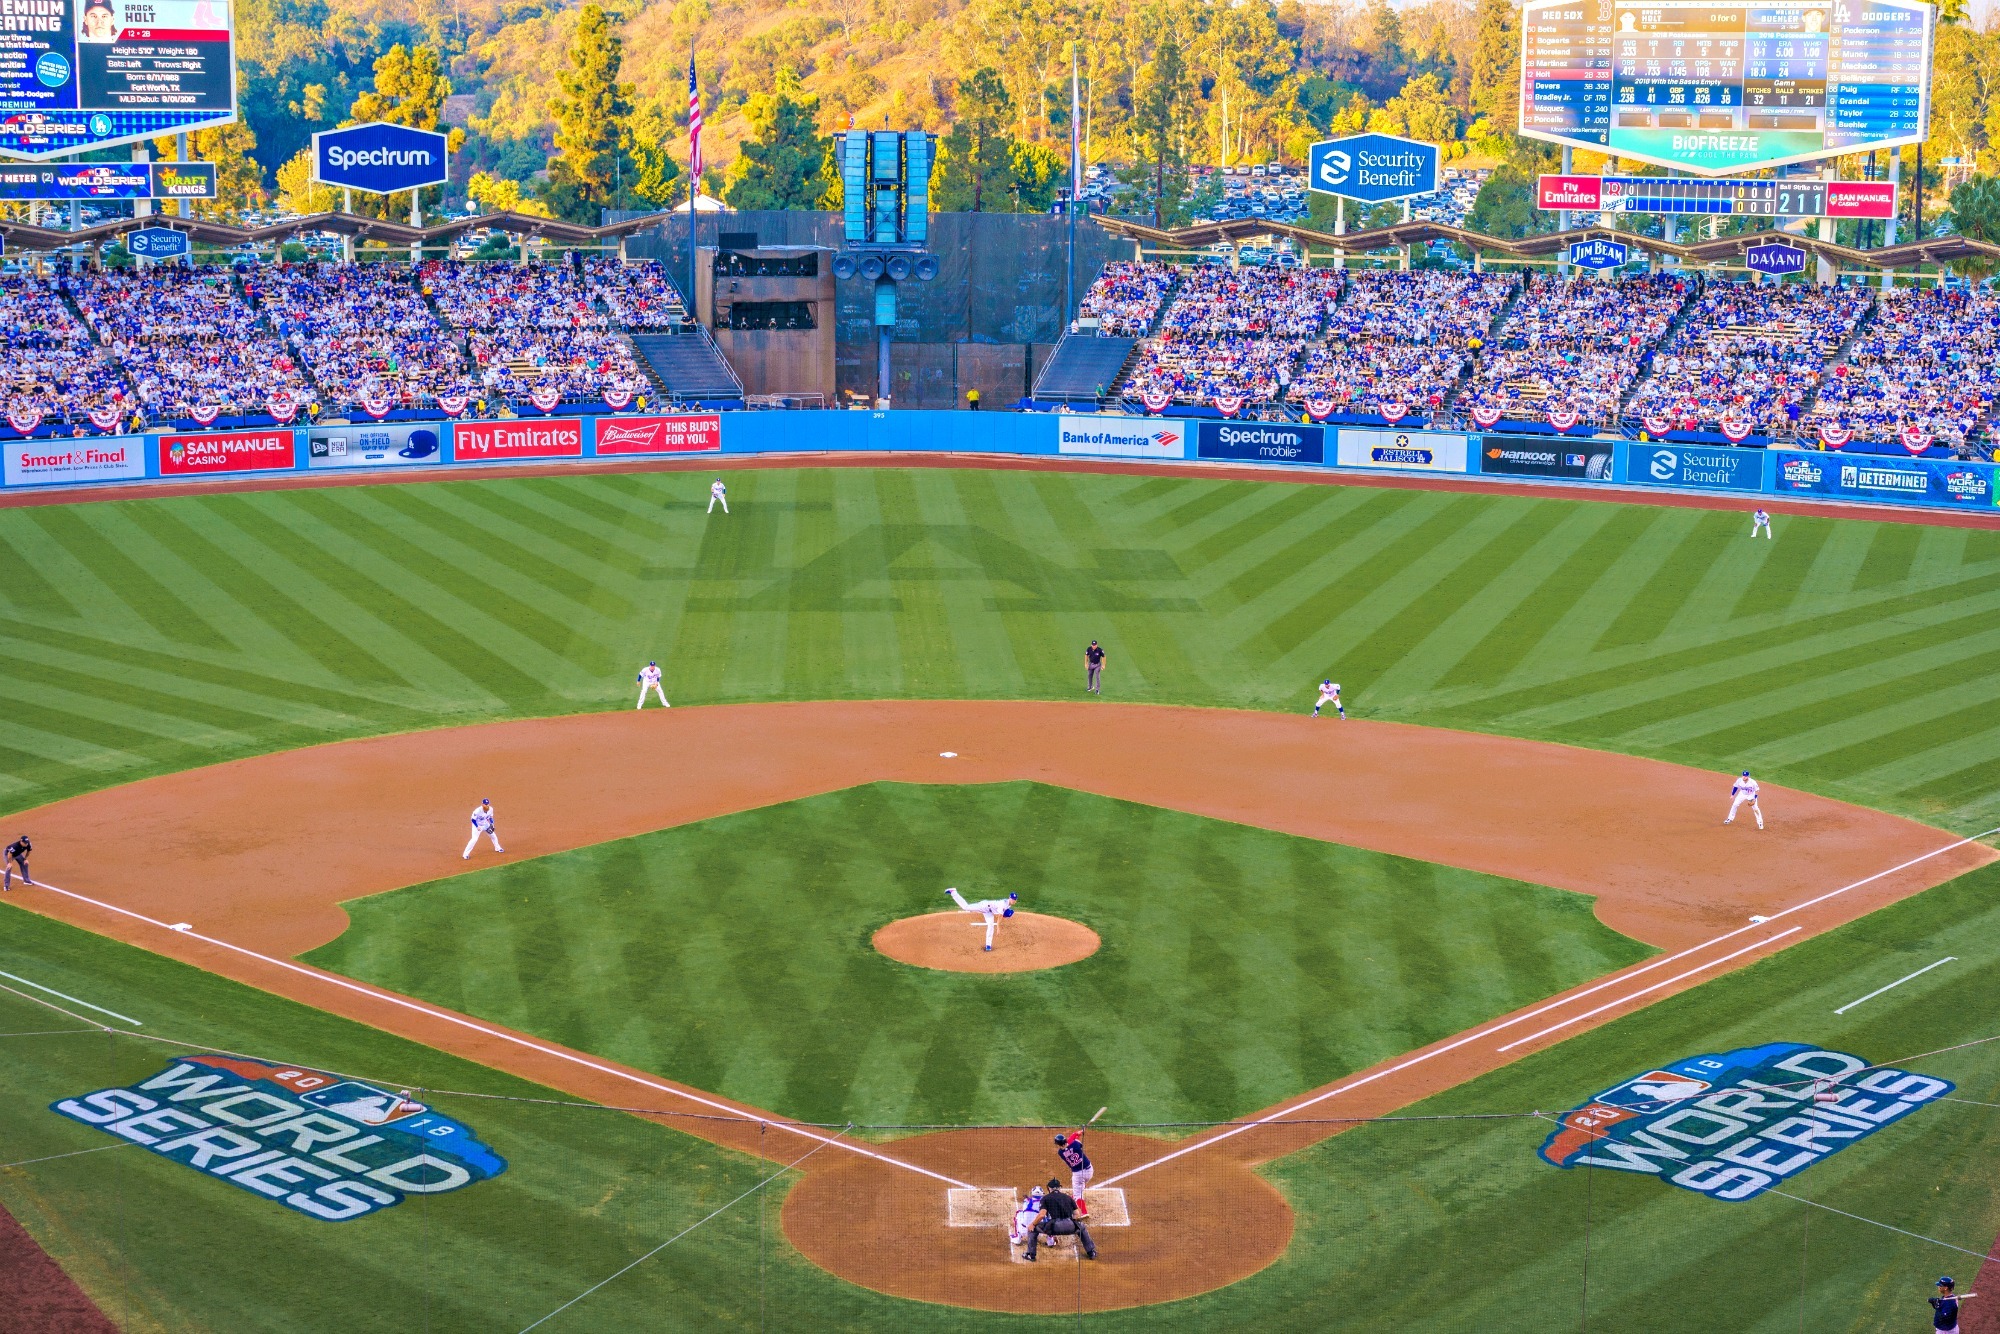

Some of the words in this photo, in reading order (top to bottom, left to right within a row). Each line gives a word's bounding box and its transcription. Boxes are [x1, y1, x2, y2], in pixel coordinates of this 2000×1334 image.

[125, 13, 155, 22] HOLT
[1542, 11, 1561, 19] RED
[1564, 11, 1583, 19] SOX
[1862, 12, 1911, 21] DODGERS
[112, 47, 137, 57] Height:
[158, 48, 184, 56] Weight:
[1621, 47, 1636, 56] .333
[1776, 47, 1793, 57] 5.00
[1804, 47, 1820, 57] 1.00
[1842, 51, 1868, 59] Muncy
[182, 62, 201, 70] Right
[1620, 66, 1635, 76] .412
[1645, 67, 1660, 76] .733
[1669, 67, 1686, 76] 1.145
[1722, 67, 1733, 76] 2.1
[1751, 68, 1766, 77] 18.0
[1779, 68, 1788, 77] 24
[1841, 86, 1857, 94] Puig
[1535, 94, 1562, 102] Bradley
[1618, 94, 1634, 103] .236
[1647, 94, 1655, 103] 41
[1668, 94, 1685, 103] .293
[1754, 95, 1763, 104] 32
[1805, 95, 1813, 105] 21
[36, 124, 86, 134] SERIES
[328, 146, 429, 170] Spectrum
[1358, 151, 1425, 171] Security
[5, 174, 36, 183] METER
[58, 176, 103, 185] WORLD
[103, 177, 145, 185] SERIES
[163, 176, 207, 187] DRAFT
[1358, 169, 1415, 186] Benefit
[168, 185, 207, 194] KINGS
[1563, 183, 1578, 192] Fly
[1545, 191, 1596, 204] Emirates
[1738, 187, 1745, 198] 0
[1752, 187, 1758, 198] 0
[1765, 187, 1772, 199] 0
[1838, 194, 1855, 202] SAN
[1738, 201, 1744, 212] 0
[1750, 201, 1757, 212] 0
[1764, 202, 1771, 213] 0
[1780, 193, 1790, 213] 2
[1798, 193, 1804, 213] 1
[1814, 193, 1821, 214] 1
[151, 235, 182, 244] Security
[151, 243, 177, 251] Benefit
[1572, 245, 1593, 263] JIM
[1750, 253, 1801, 268] DASANI
[665, 422, 687, 433] THIS
[689, 421, 718, 432] BUD'S
[605, 429, 655, 440] Budweiser
[665, 434, 685, 444] FOR
[686, 433, 708, 444] YOU.
[1063, 432, 1092, 443] Bank
[1092, 433, 1103, 444] of
[1104, 434, 1149, 446] America
[1219, 427, 1297, 446] Spectrum
[360, 438, 390, 446] ON-FIELD
[458, 431, 490, 452] Fly
[493, 428, 579, 448] Emirates
[187, 441, 218, 454] SAN
[222, 438, 285, 453] MANUEL
[21, 452, 72, 467] Smart
[74, 451, 84, 464] &
[86, 448, 125, 463] Final
[187, 455, 227, 465] CASINO
[1378, 454, 1415, 463] JALISCO
[1683, 453, 1740, 471] Security
[1683, 468, 1730, 483] Benefit
[1784, 467, 1822, 475] WORLD
[1784, 473, 1821, 482] SERIES
[1860, 472, 1928, 489] DETERMINED
[1947, 477, 1987, 487] WORLD
[1947, 485, 1986, 495] SERIES
[1684, 1059, 1724, 1076] 18
[275, 1070, 324, 1088] 20
[1574, 1050, 1867, 1174] WORLD
[1575, 1107, 1621, 1126] 20
[139, 1063, 470, 1193] WORLD
[409, 1119, 455, 1137] 18
[1672, 1069, 1949, 1199] SERIES
[58, 1089, 396, 1220] SERIES
